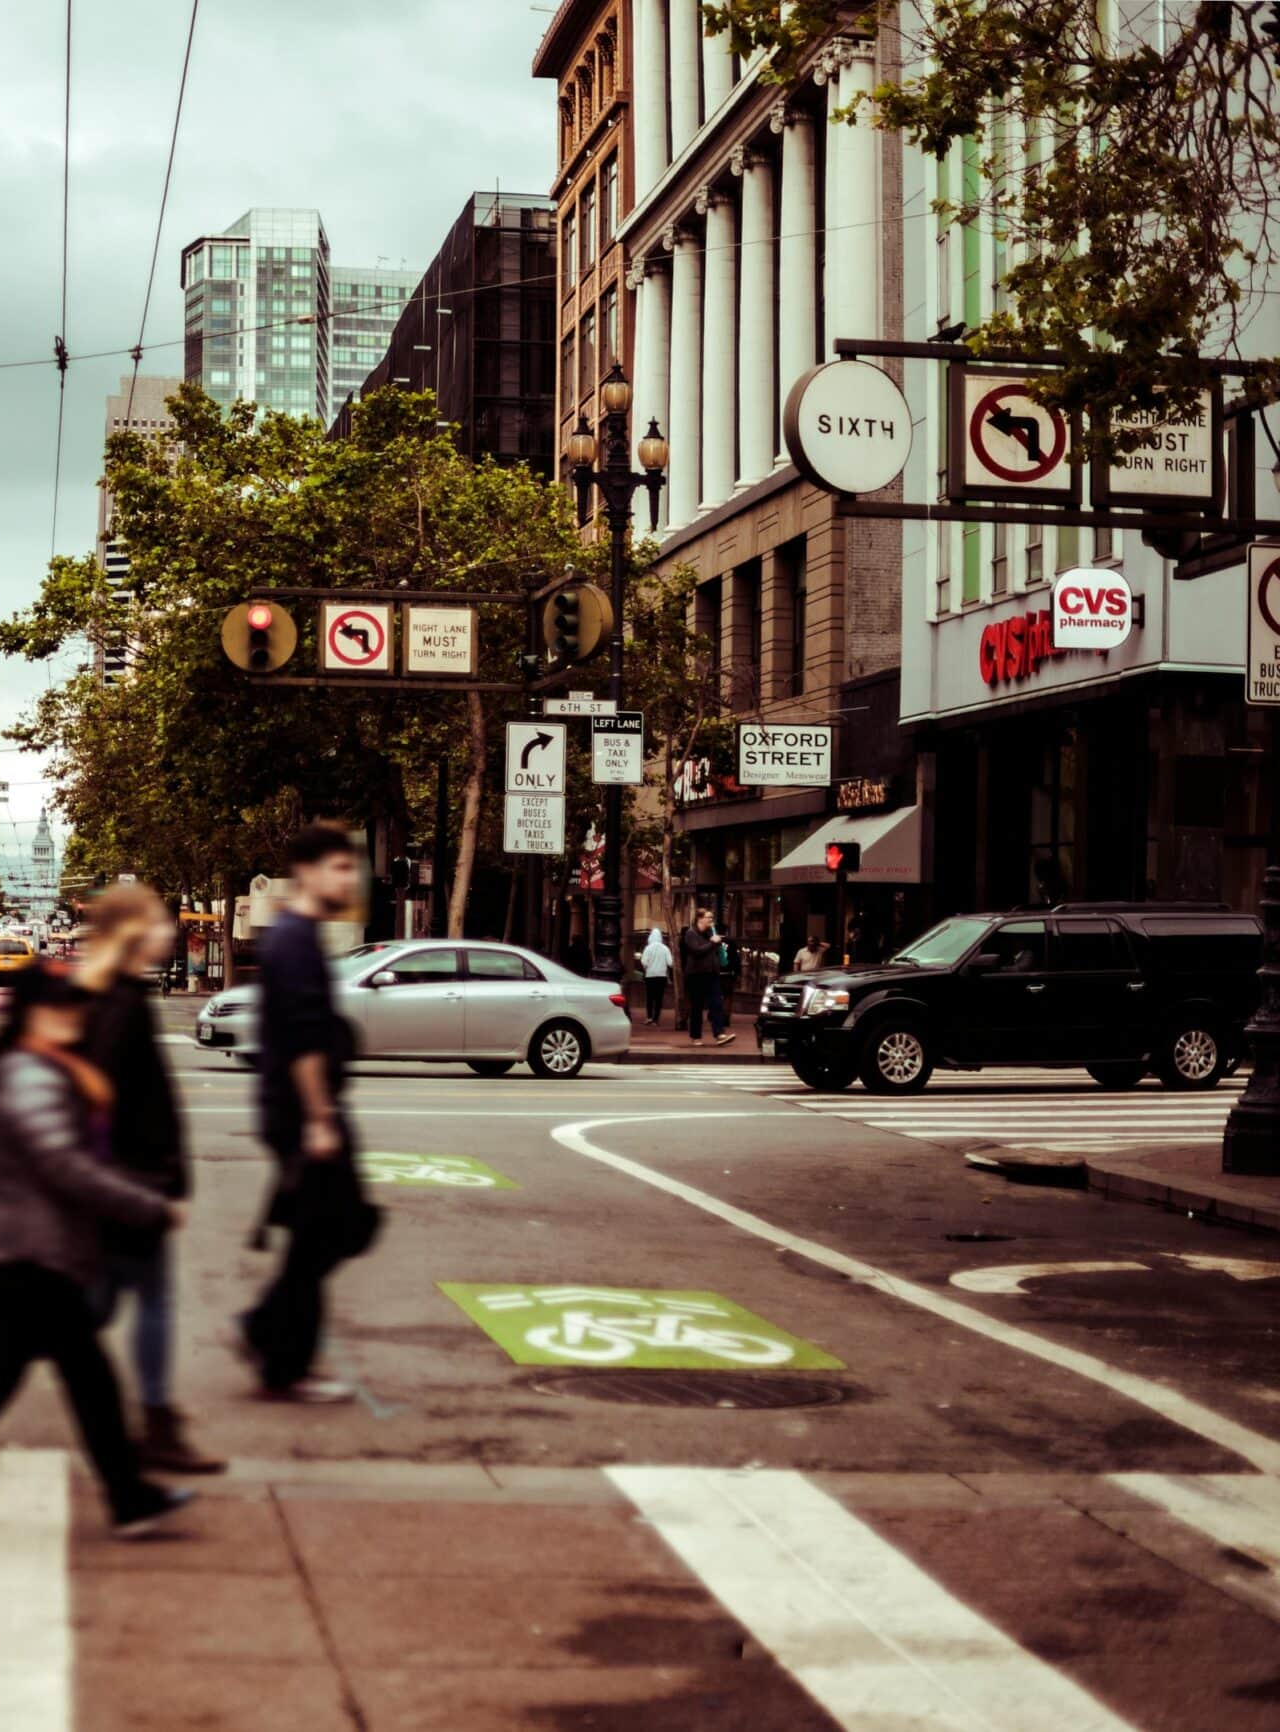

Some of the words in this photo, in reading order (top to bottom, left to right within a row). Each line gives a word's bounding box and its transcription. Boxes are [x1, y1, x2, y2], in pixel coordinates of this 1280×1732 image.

[1136, 431, 1189, 453] UST
[1122, 456, 1153, 471] URN
[1164, 458, 1208, 473] RIGHT
[1058, 586, 1128, 616] CVS
[412, 624, 438, 633] RIGHT
[443, 625, 468, 634] LANE
[1059, 616, 1126, 631] pharmacy
[422, 635, 457, 648] MUST
[412, 649, 436, 659] TURN
[441, 650, 467, 660] RIGHT
[559, 703, 580, 713] 6TH
[589, 703, 602, 713] ST
[594, 719, 614, 729] LEFT
[617, 719, 641, 729] LANE
[603, 738, 621, 748] BUS
[623, 739, 631, 748] &
[742, 731, 829, 748] OXFORD
[607, 748, 627, 757] TAXI
[604, 759, 629, 769] ONLY
[744, 750, 825, 767] STREET
[514, 772, 556, 787] ONLY
[742, 770, 779, 781] Designer
[785, 771, 829, 781] Menswear
[521, 797, 549, 807] EXCEPT
[523, 807, 547, 818] BUSES
[516, 818, 552, 829] BICYCLES
[524, 829, 545, 840] TAXIS
[527, 840, 554, 850] TRUCKS
